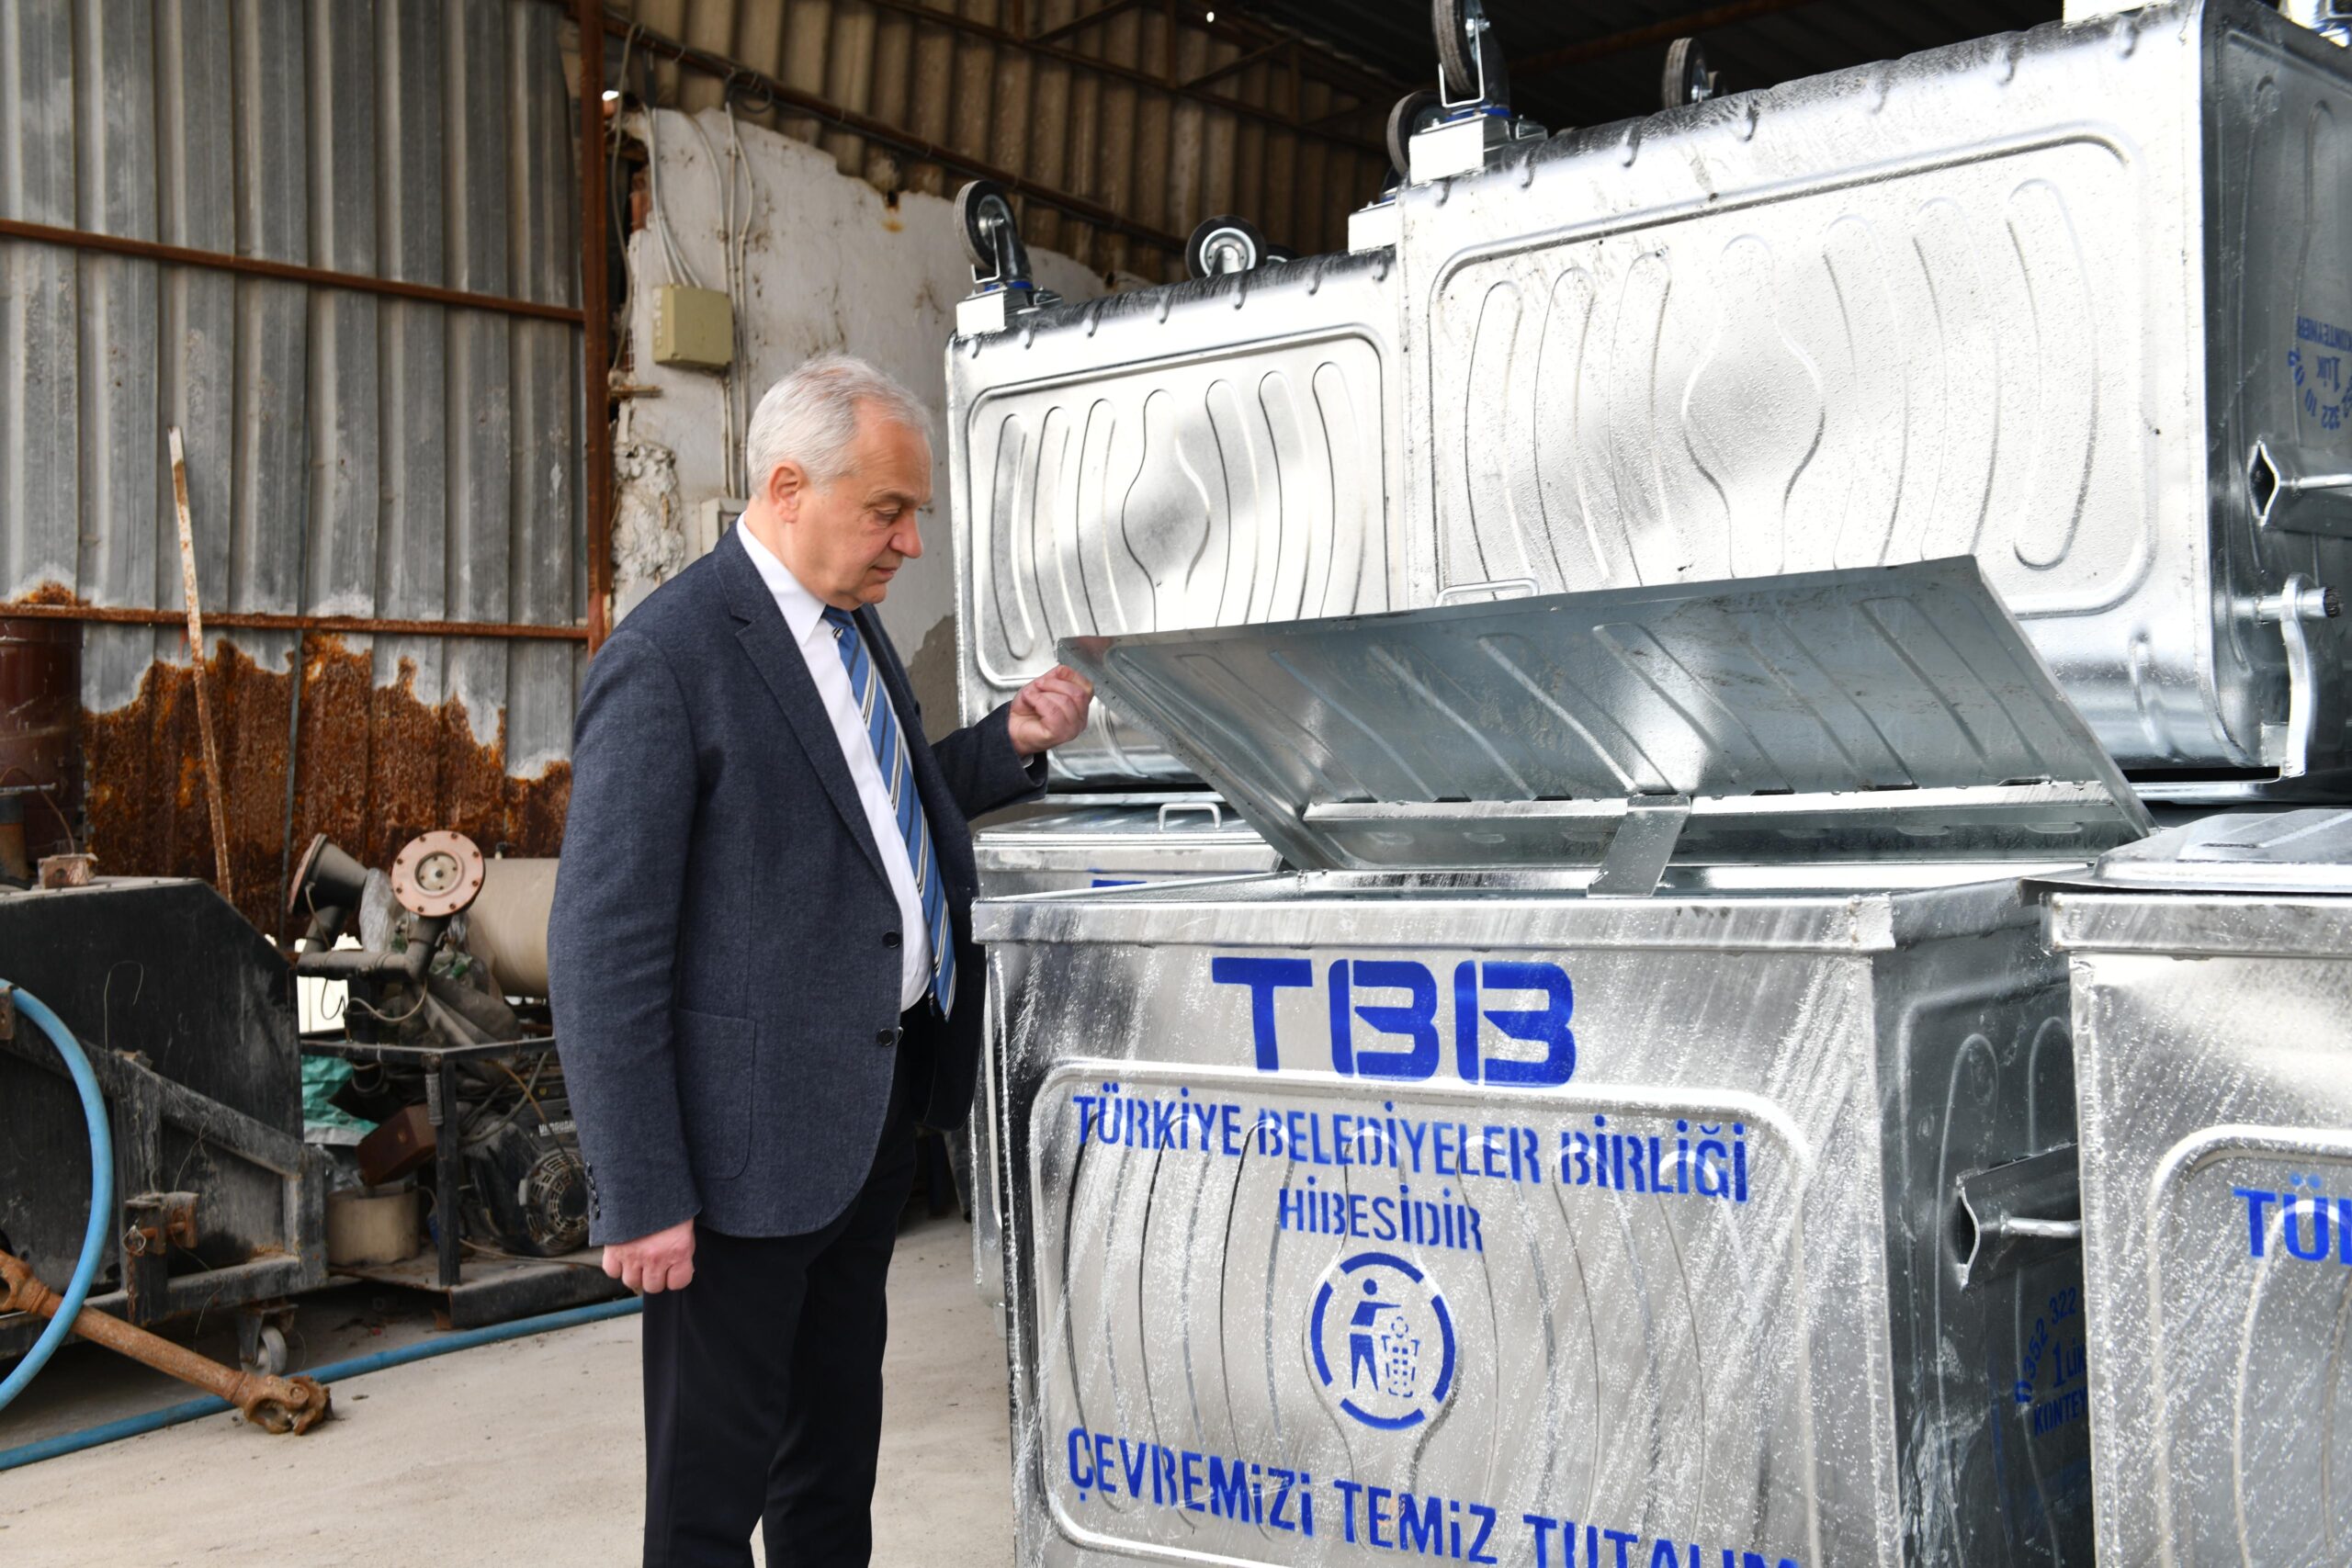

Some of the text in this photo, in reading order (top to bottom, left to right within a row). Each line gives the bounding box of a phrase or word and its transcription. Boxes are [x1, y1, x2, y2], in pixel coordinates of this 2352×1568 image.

[1212, 956, 1577, 1089] TBB
[1073, 1082, 1747, 1203] TÜRKİYE BELEDİYELER BİRLİĞİ
[1279, 1176, 1483, 1253] HİBESİDİR
[2023, 1317, 2049, 1380] 352
[2050, 1287, 2076, 1325] 322
[2052, 1340, 2066, 1388] 1
[1523, 1514, 1799, 1568] TUTA
